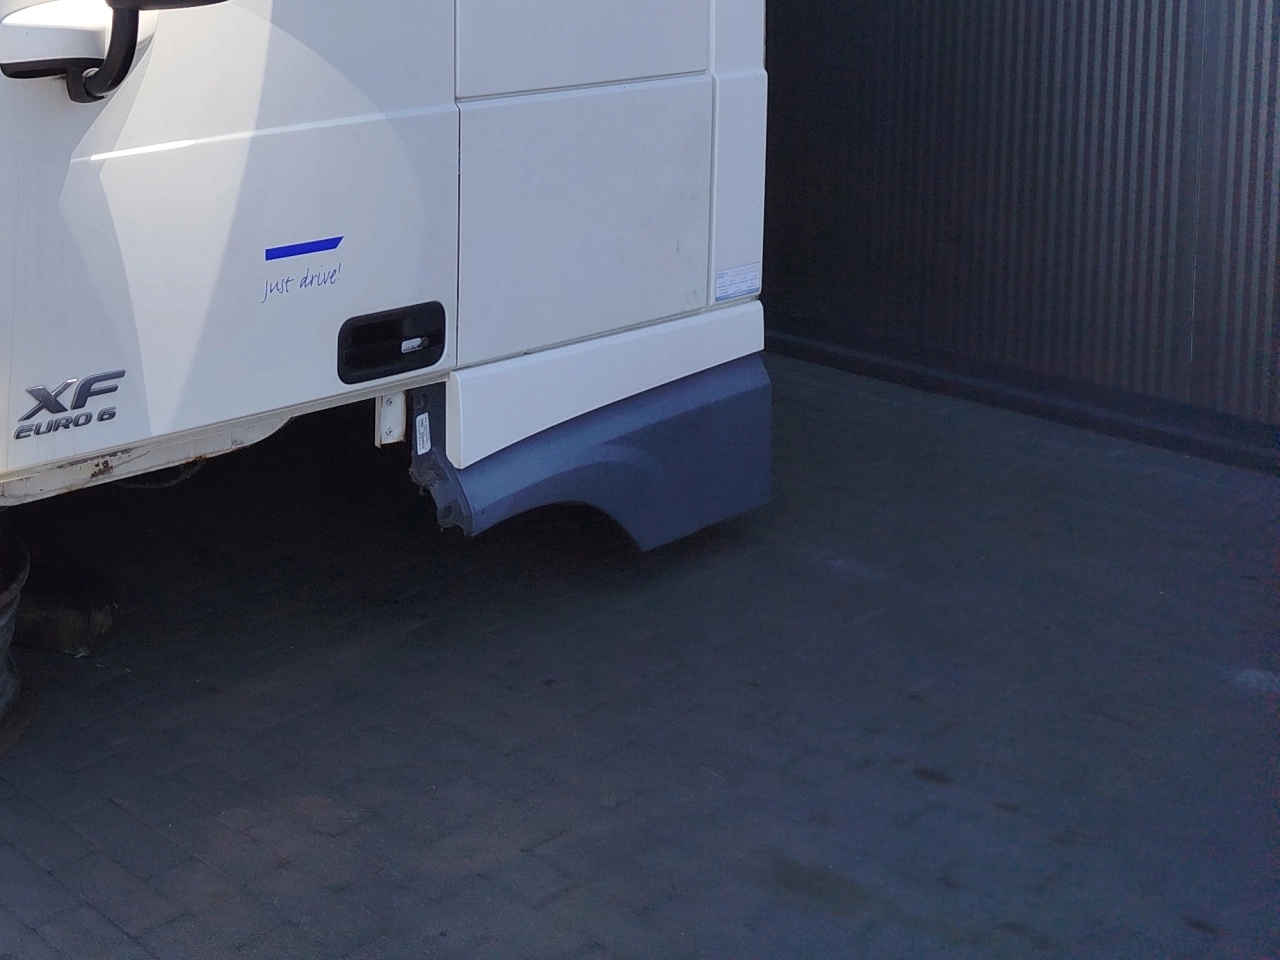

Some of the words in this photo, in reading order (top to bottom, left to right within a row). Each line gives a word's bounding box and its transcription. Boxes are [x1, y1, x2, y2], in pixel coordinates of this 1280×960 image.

[261, 276, 295, 304] just
[300, 262, 342, 289] drive!
[18, 368, 126, 422] XF
[13, 411, 93, 440] EURO
[97, 405, 117, 422] 6
